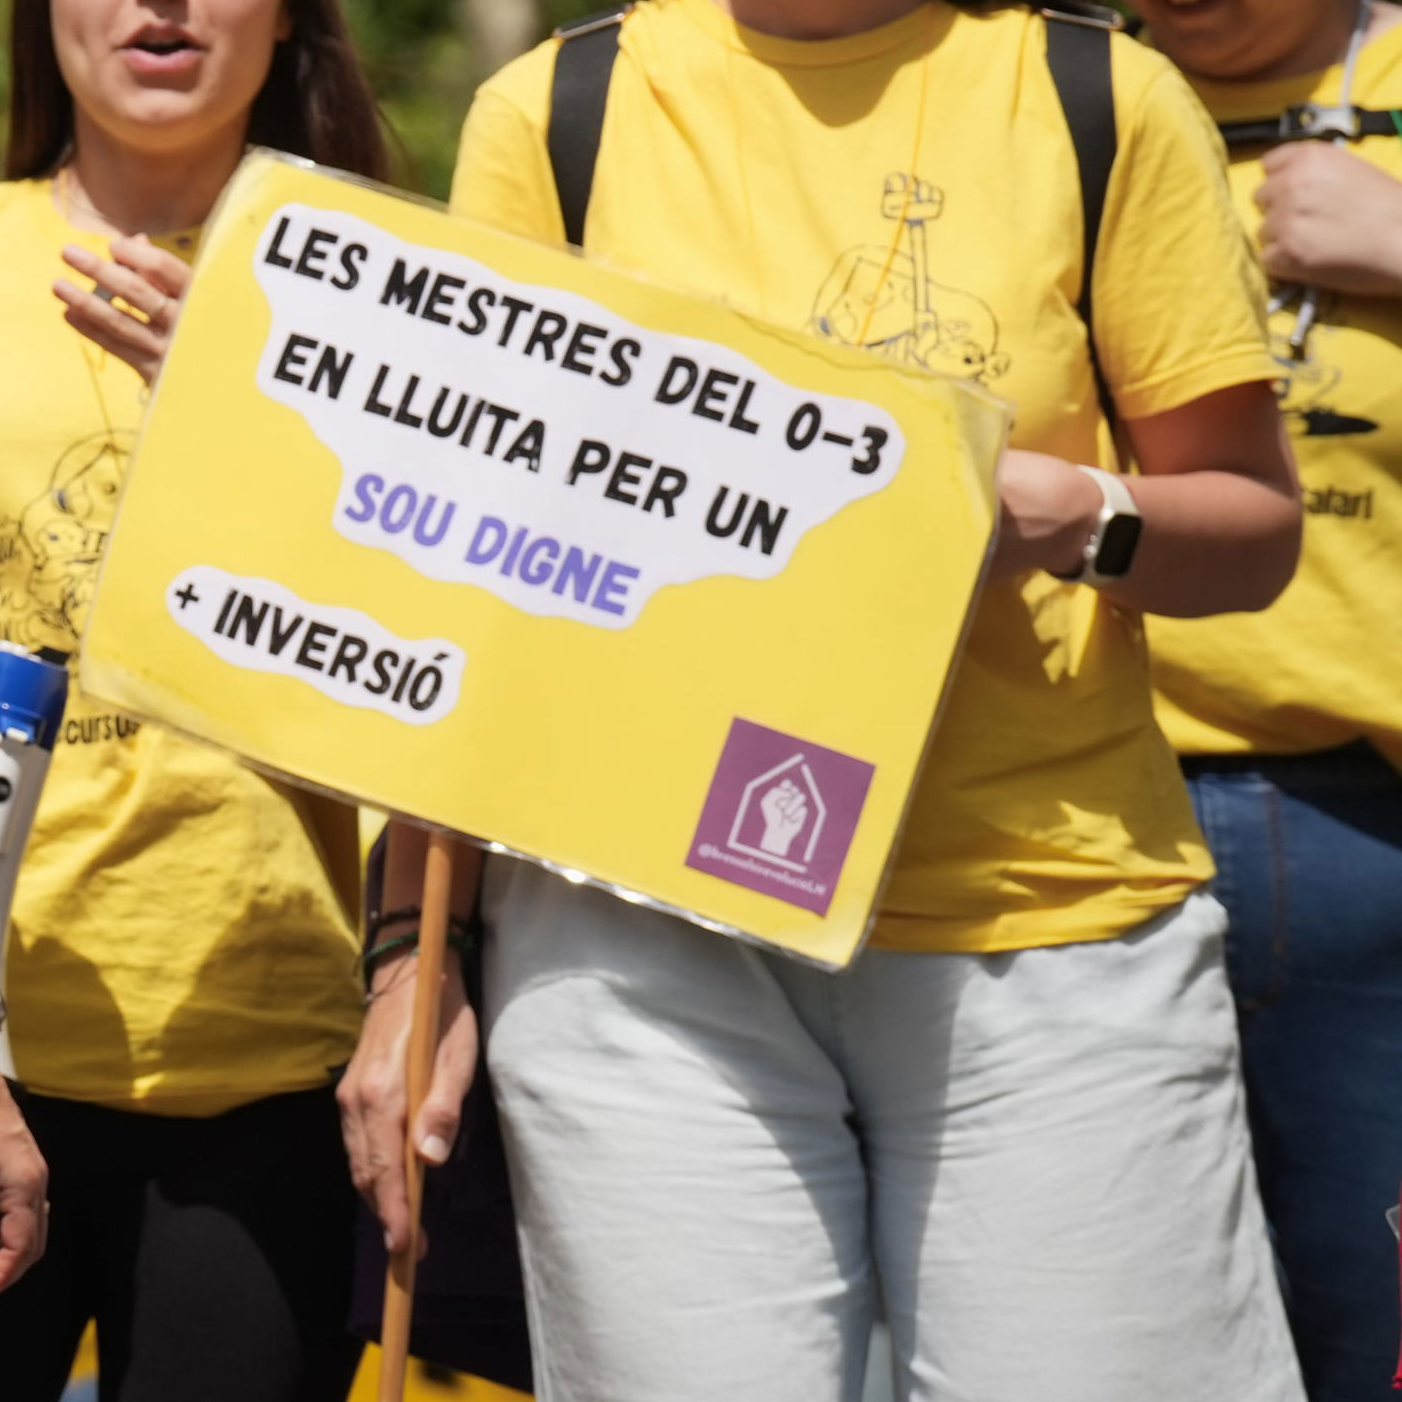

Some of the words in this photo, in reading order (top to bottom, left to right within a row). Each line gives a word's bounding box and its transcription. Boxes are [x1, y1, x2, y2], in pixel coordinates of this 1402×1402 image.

[264, 216, 368, 293] LES
[380, 257, 642, 388] MESTRES
[654, 355, 760, 436] DEL
[273, 332, 354, 401] EN
[363, 363, 546, 473] LLUITA
[567, 438, 689, 519] PER
[704, 485, 790, 557] UN
[344, 473, 456, 548] SOU
[465, 516, 641, 617] DIGNE
[213, 589, 450, 712] INVERSIÓ
